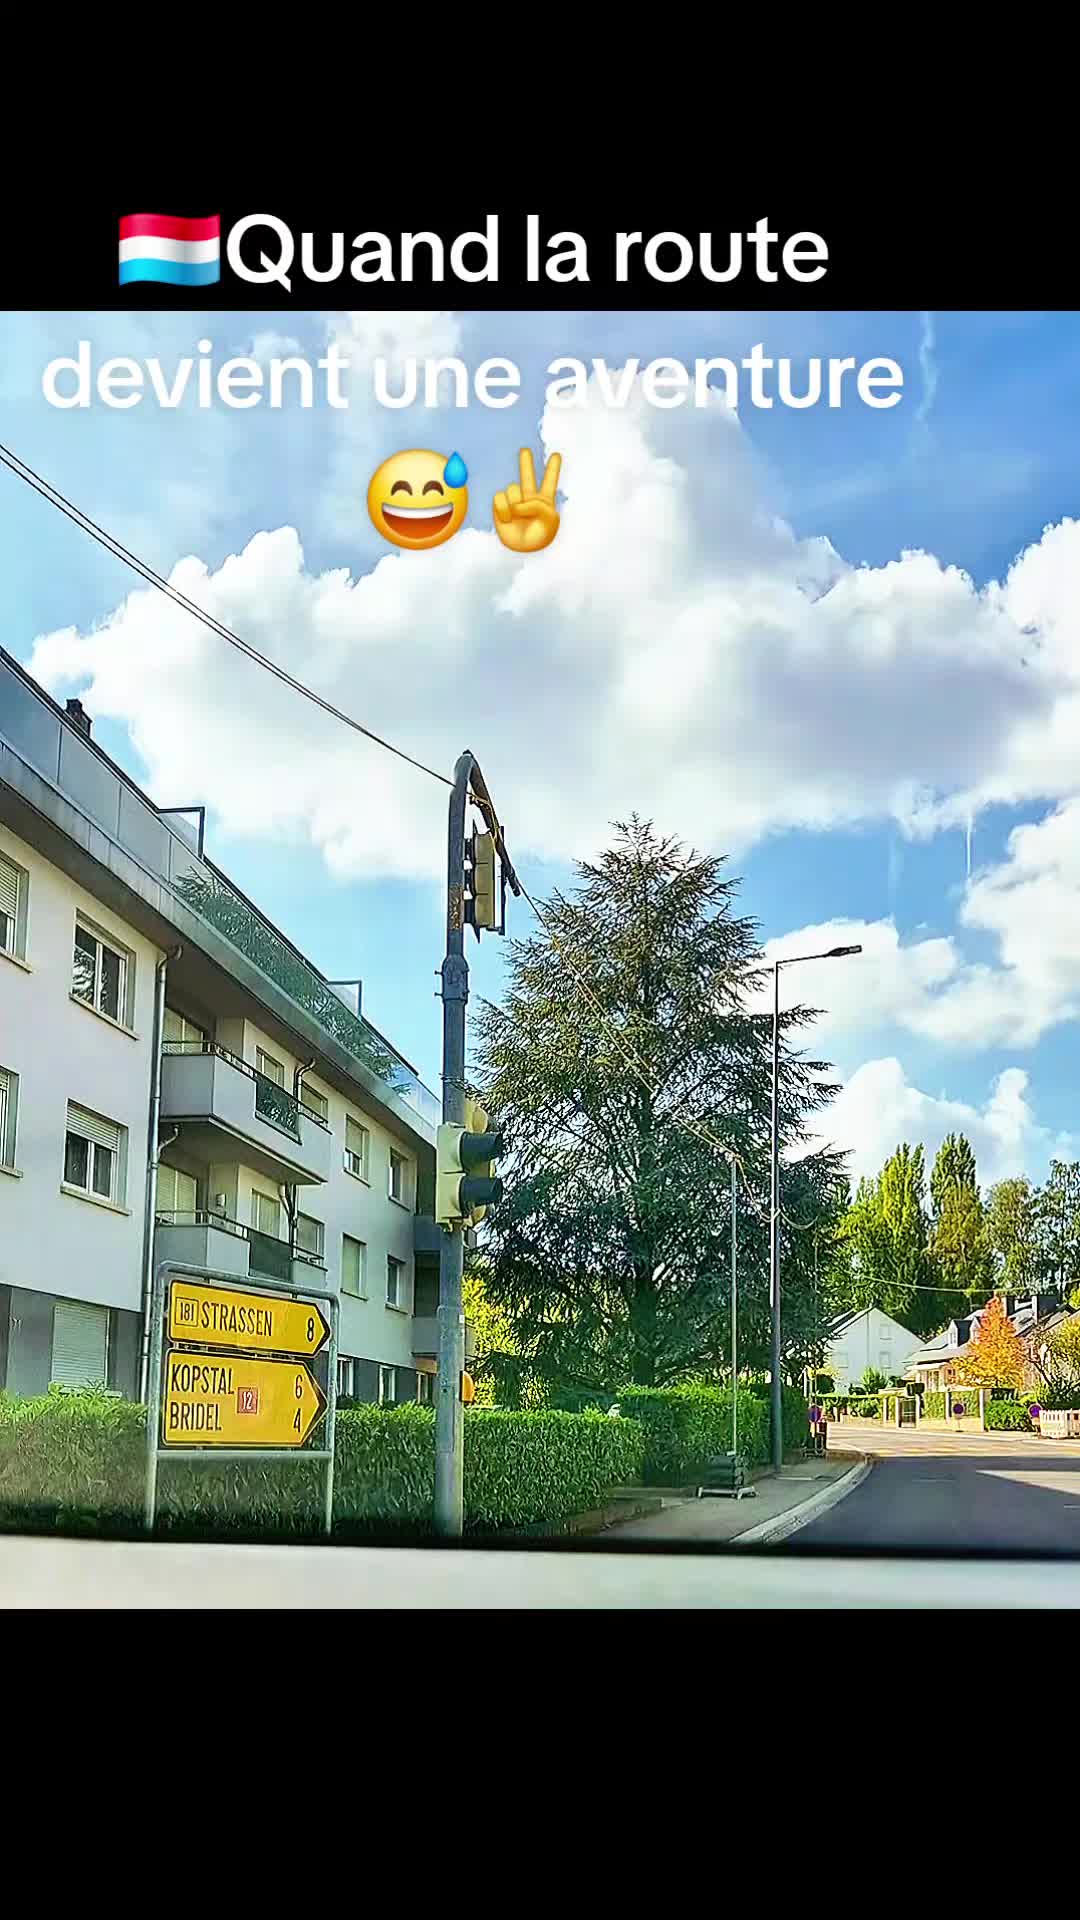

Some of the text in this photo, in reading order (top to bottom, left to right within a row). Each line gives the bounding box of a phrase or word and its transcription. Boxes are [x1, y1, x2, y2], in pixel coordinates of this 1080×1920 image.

[180, 1301, 315, 1342] 181 STRASSEN 8
[171, 1363, 303, 1399] KOPSTAL 6
[169, 1401, 301, 1433] BRIDEL 4
[242, 1392, 253, 1410] 12
